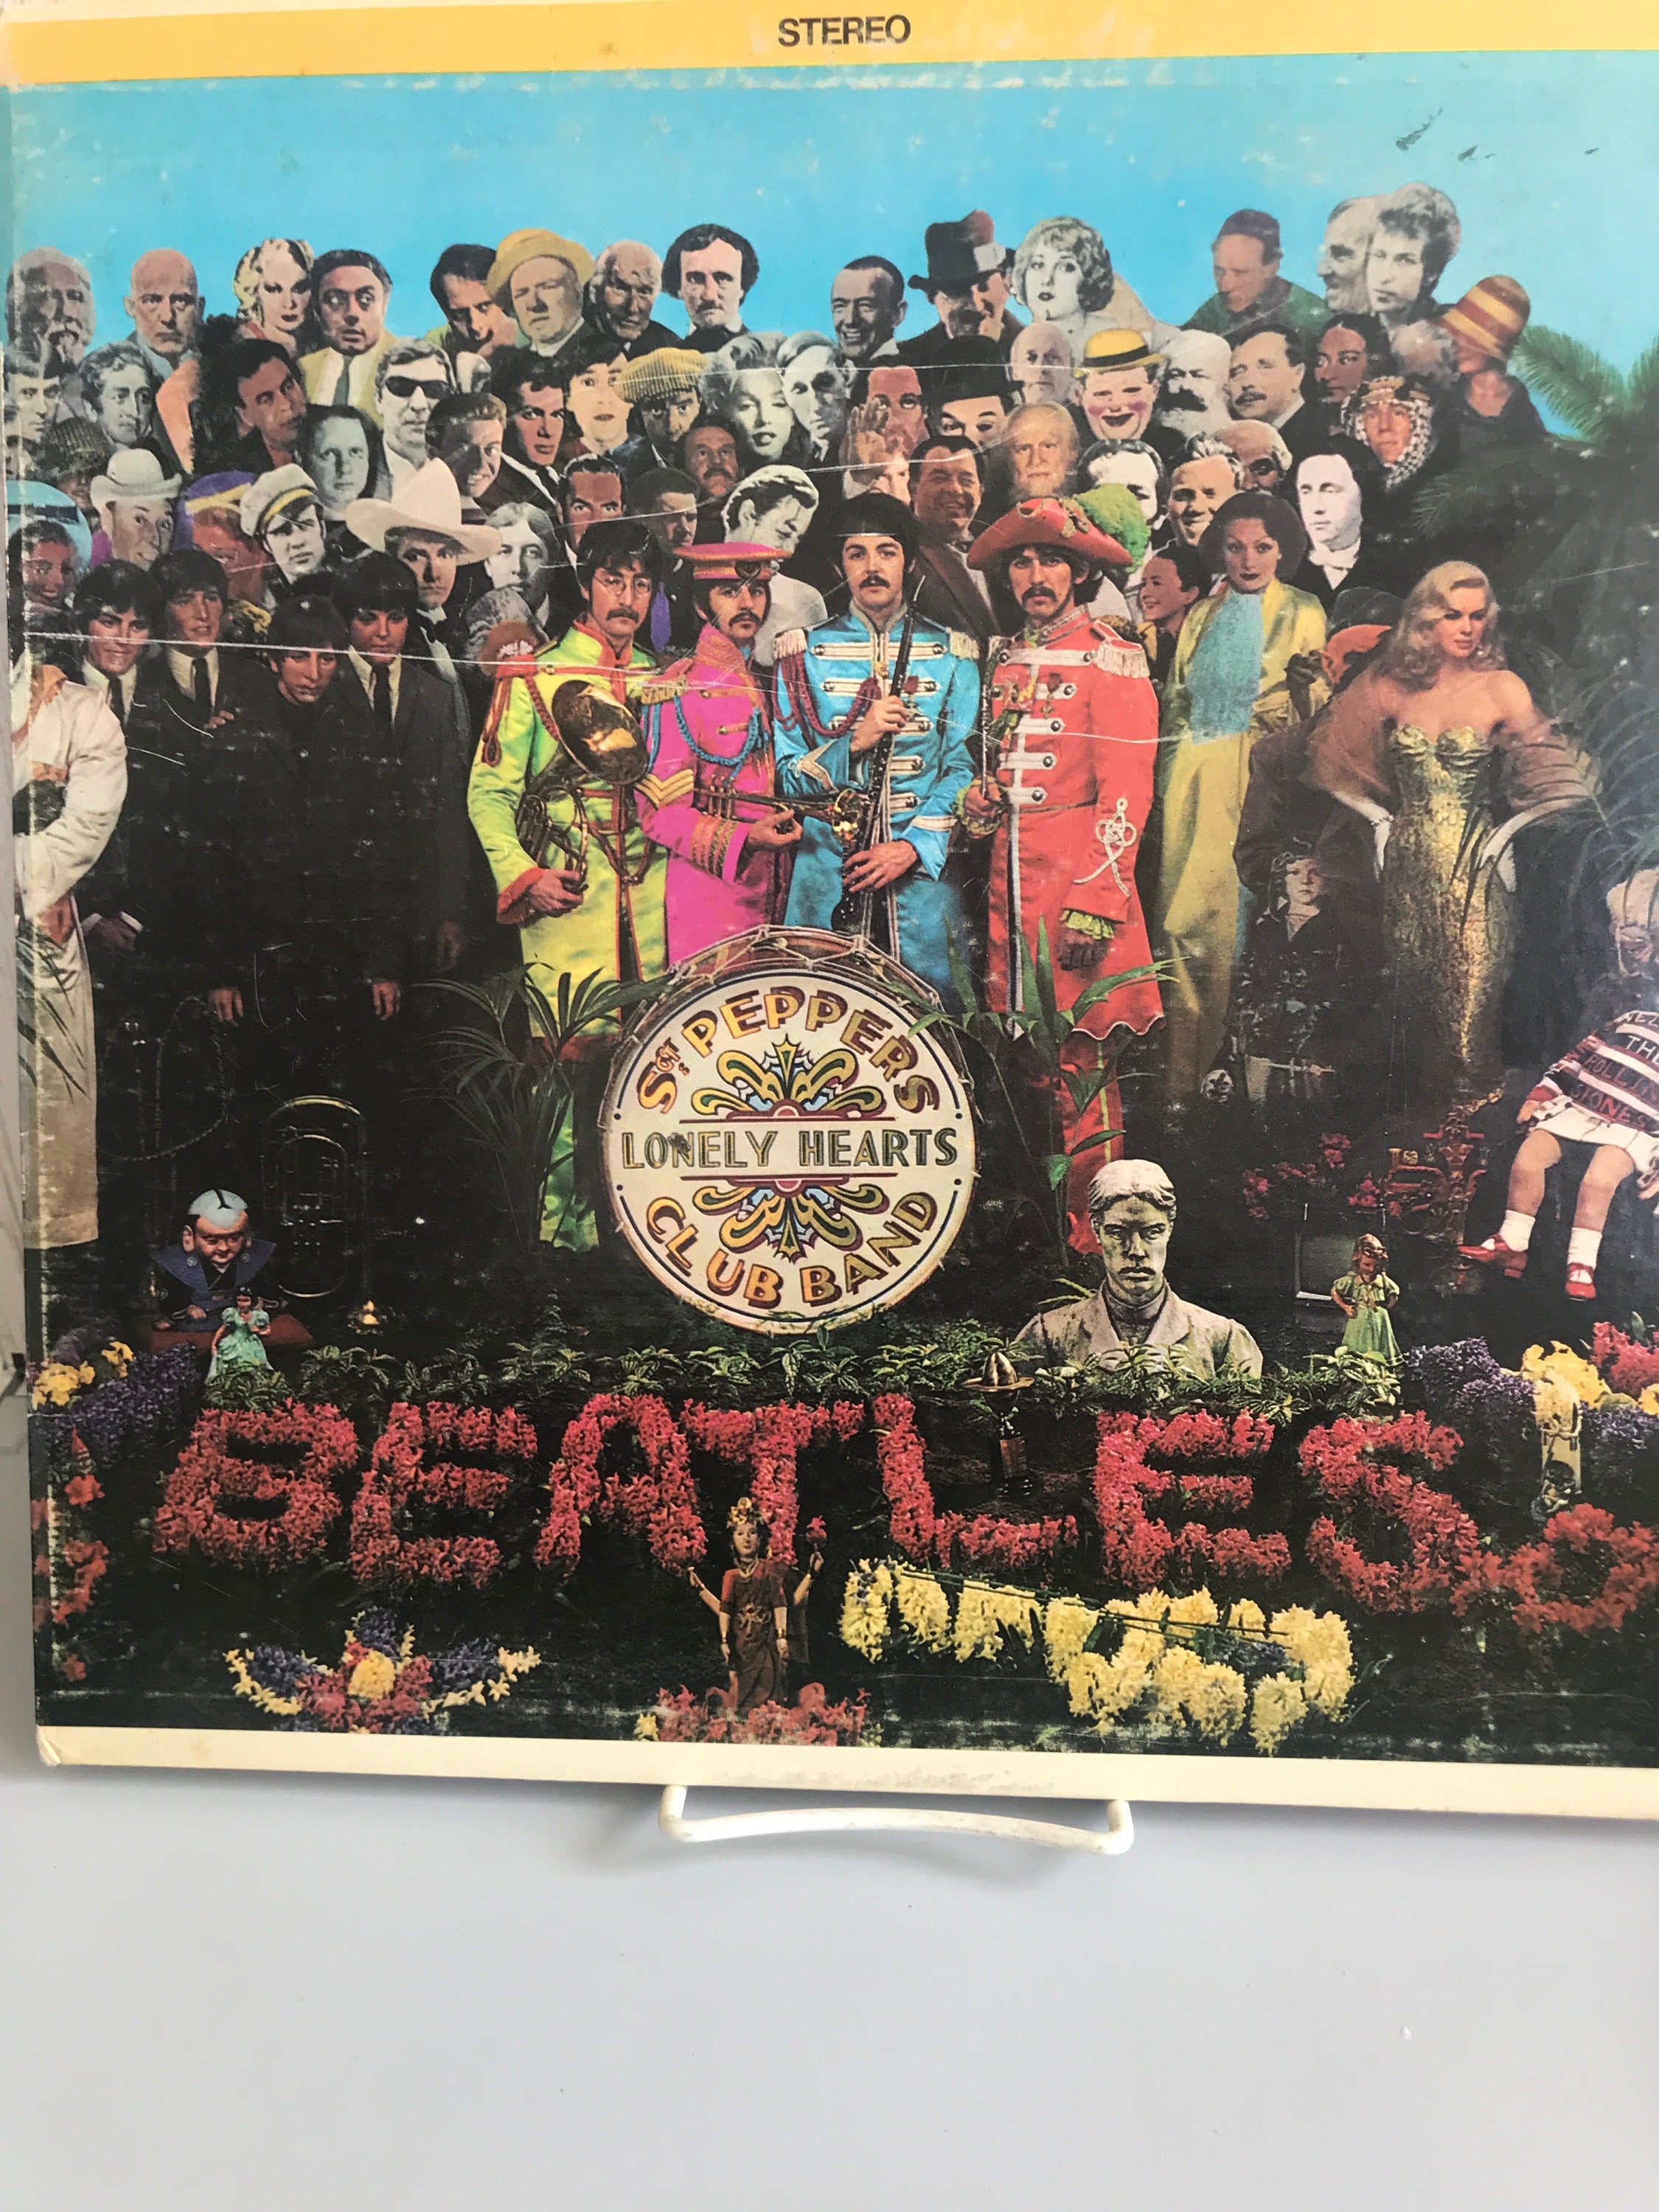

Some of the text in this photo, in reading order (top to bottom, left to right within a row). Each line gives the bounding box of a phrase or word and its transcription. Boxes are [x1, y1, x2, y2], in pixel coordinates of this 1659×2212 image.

[778, 14, 911, 47] STEREO
[682, 986, 940, 1113] PEPPERS
[1571, 1083, 1647, 1128] STONES
[622, 1128, 957, 1169] LONELY HEARTS
[646, 1192, 937, 1309] CLUB BAND
[152, 1392, 1479, 1615] BEATLES
